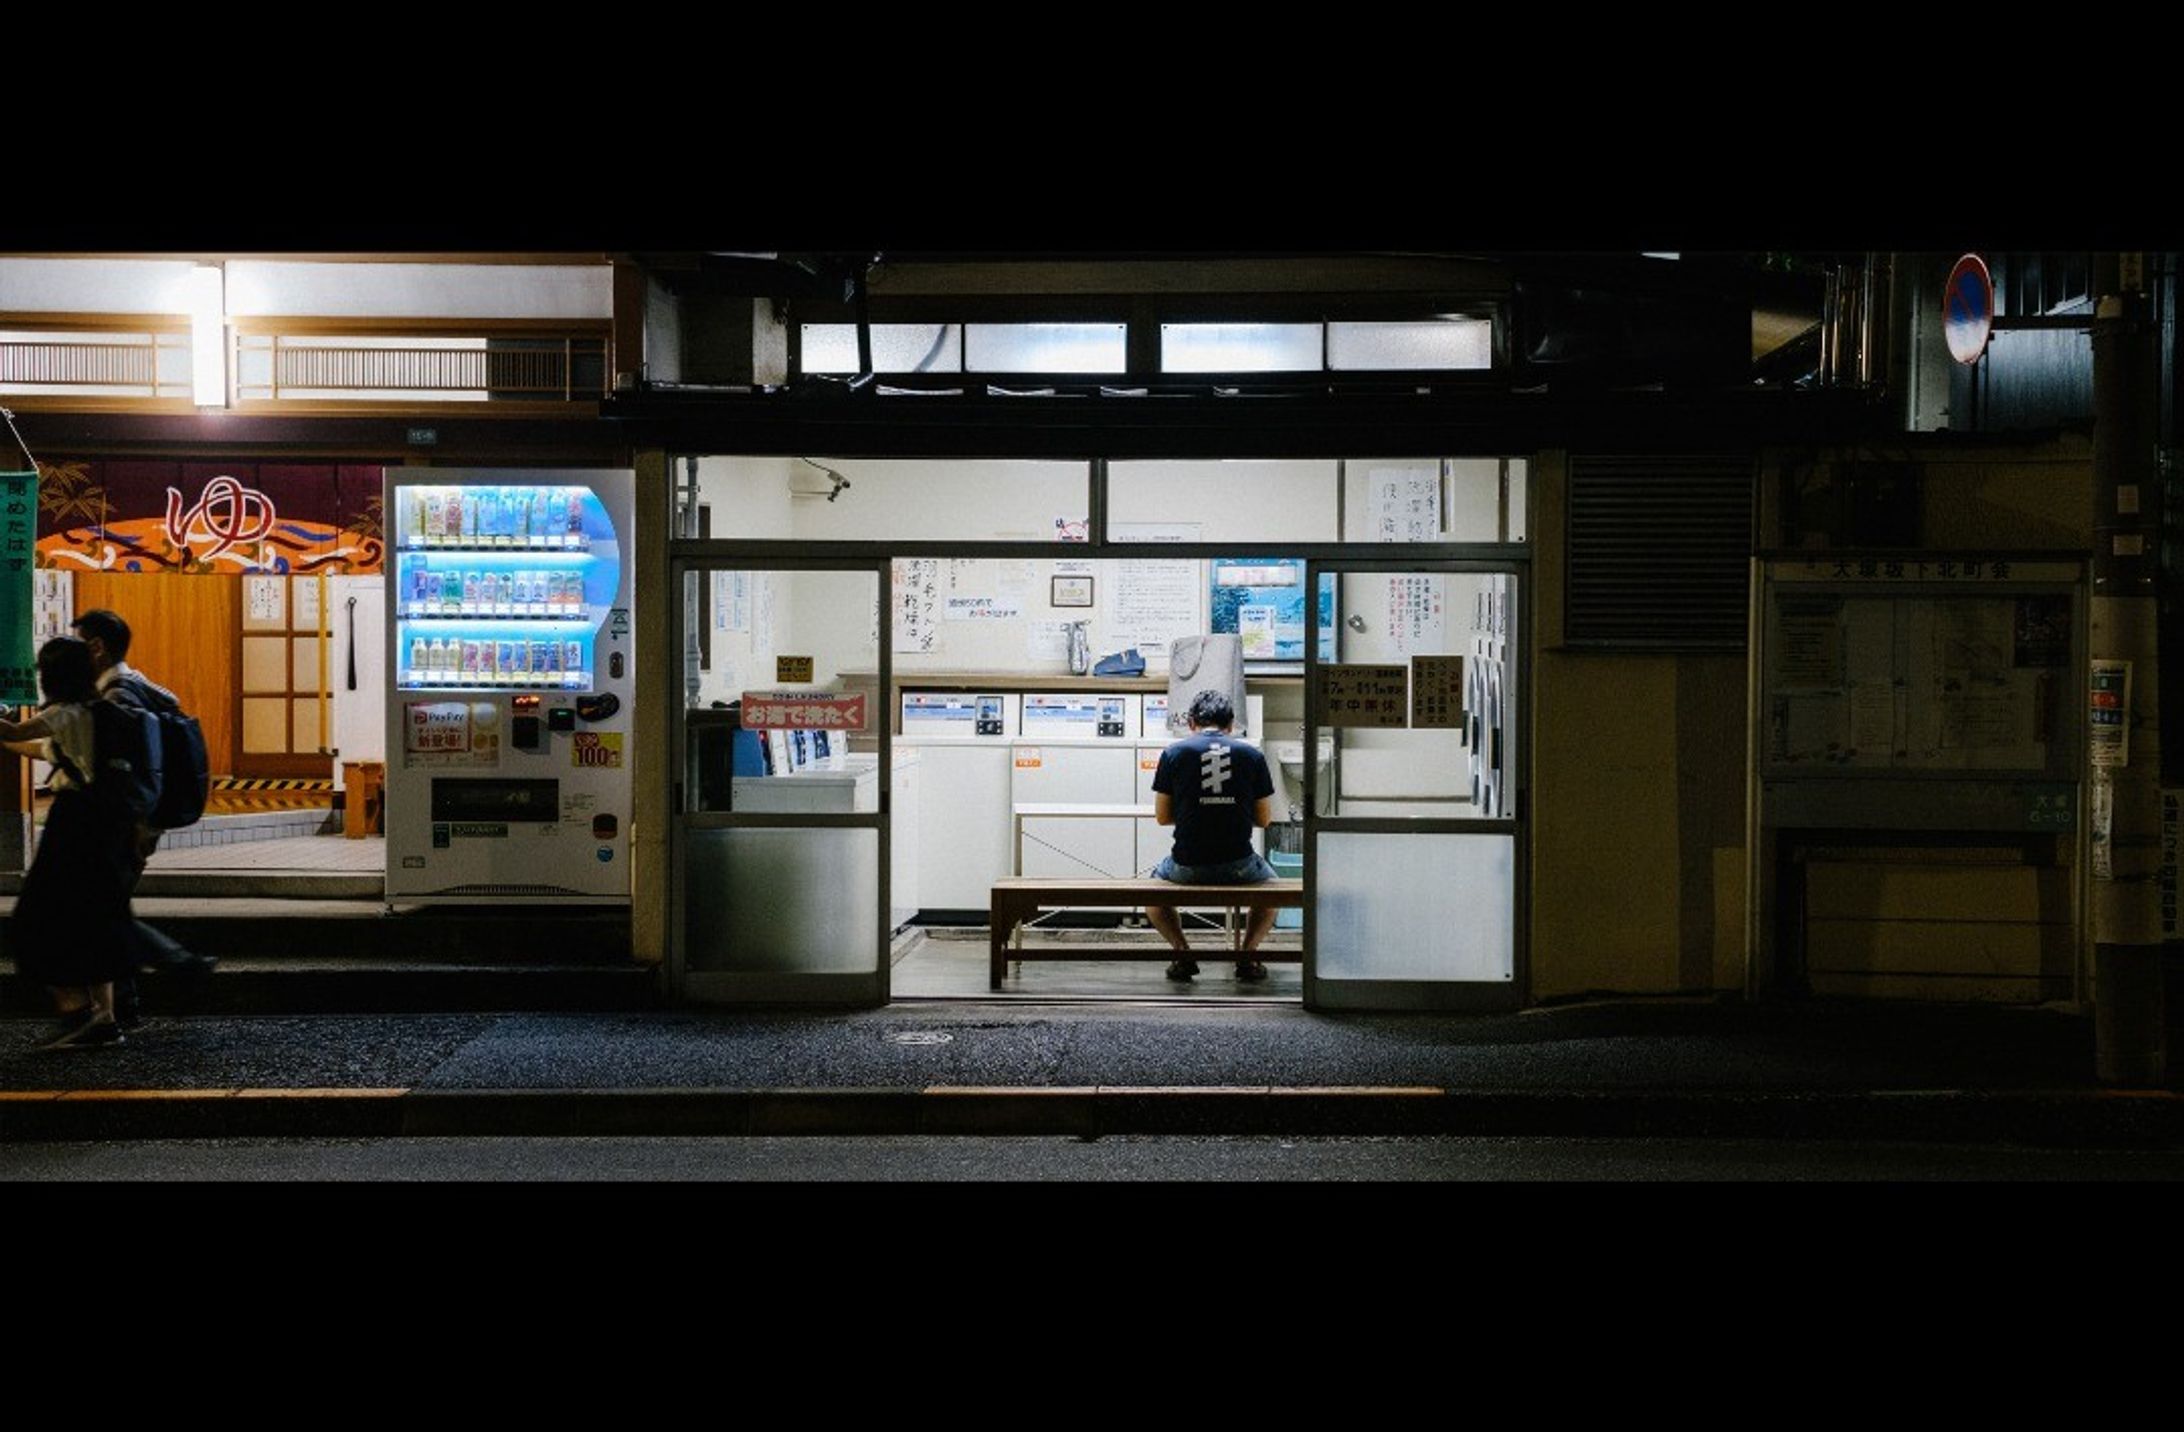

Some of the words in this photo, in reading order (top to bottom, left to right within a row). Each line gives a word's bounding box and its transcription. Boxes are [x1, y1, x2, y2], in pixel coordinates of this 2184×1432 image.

[166, 475, 275, 562] ゆ
[1329, 698, 1397, 713] 年中無休
[428, 711, 465, 723] PayPay
